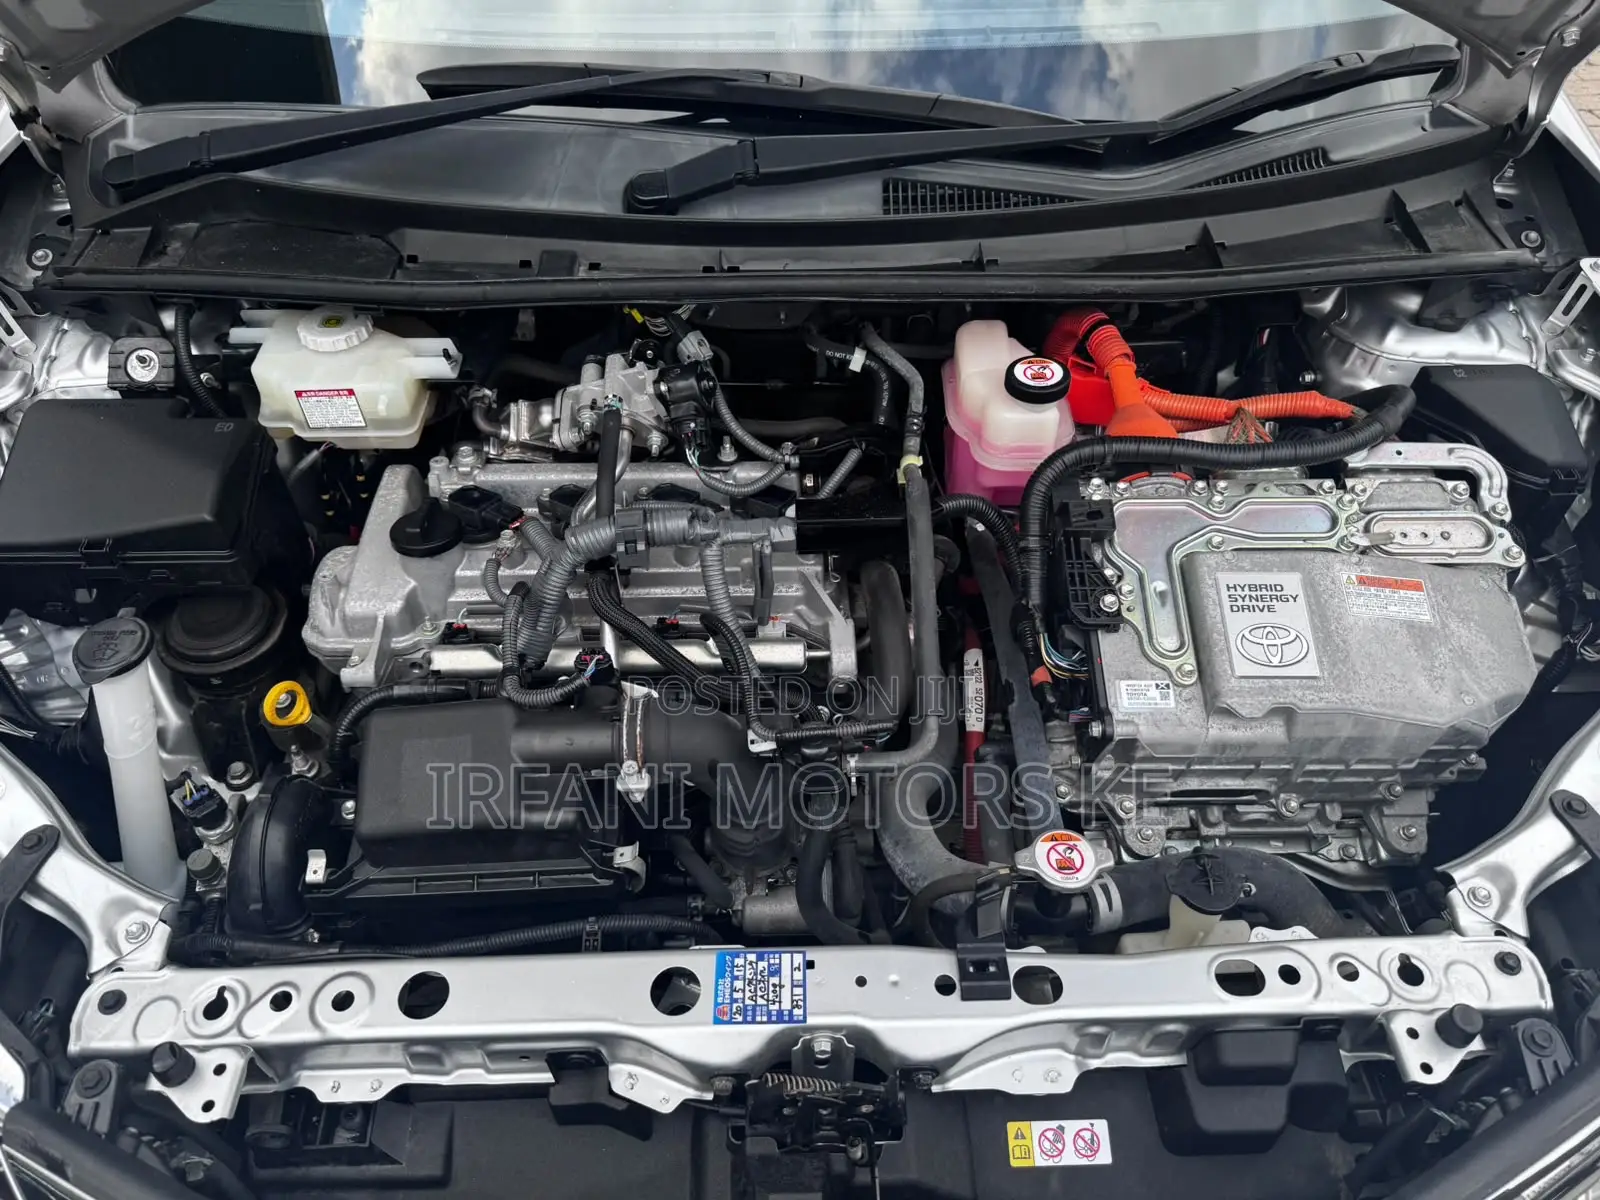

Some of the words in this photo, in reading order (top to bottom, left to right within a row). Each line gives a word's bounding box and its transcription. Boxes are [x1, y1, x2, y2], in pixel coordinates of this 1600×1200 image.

[1226, 583, 1284, 592] HYBRID
[1228, 594, 1299, 603] SYNERGY
[1230, 604, 1277, 613] DRIVE
